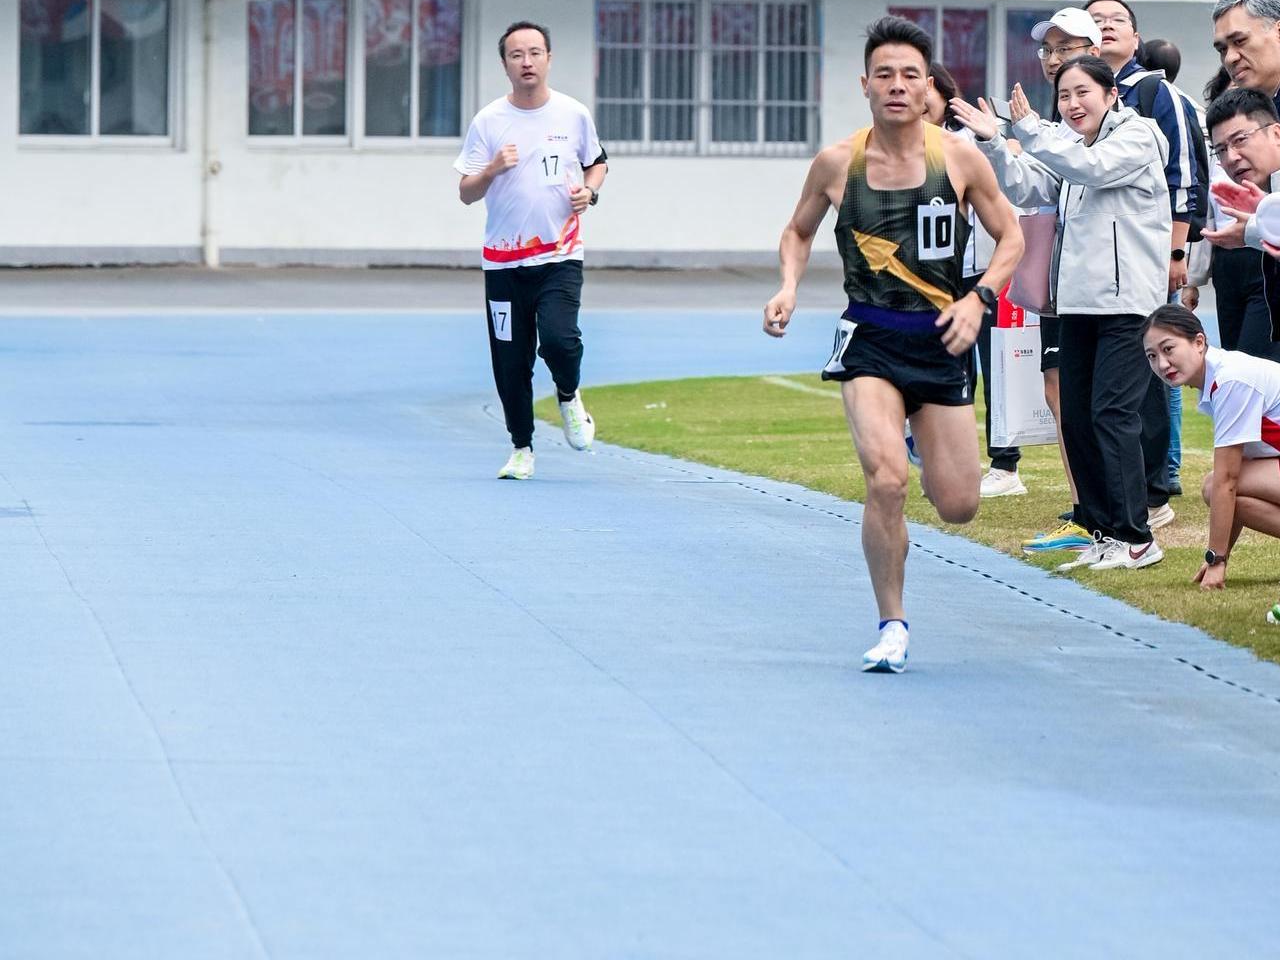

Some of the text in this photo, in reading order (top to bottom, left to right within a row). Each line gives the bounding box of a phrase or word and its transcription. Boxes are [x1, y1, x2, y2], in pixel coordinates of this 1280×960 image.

[541, 154, 559, 177] 17
[922, 214, 952, 249] 10
[493, 310, 508, 332] 17
